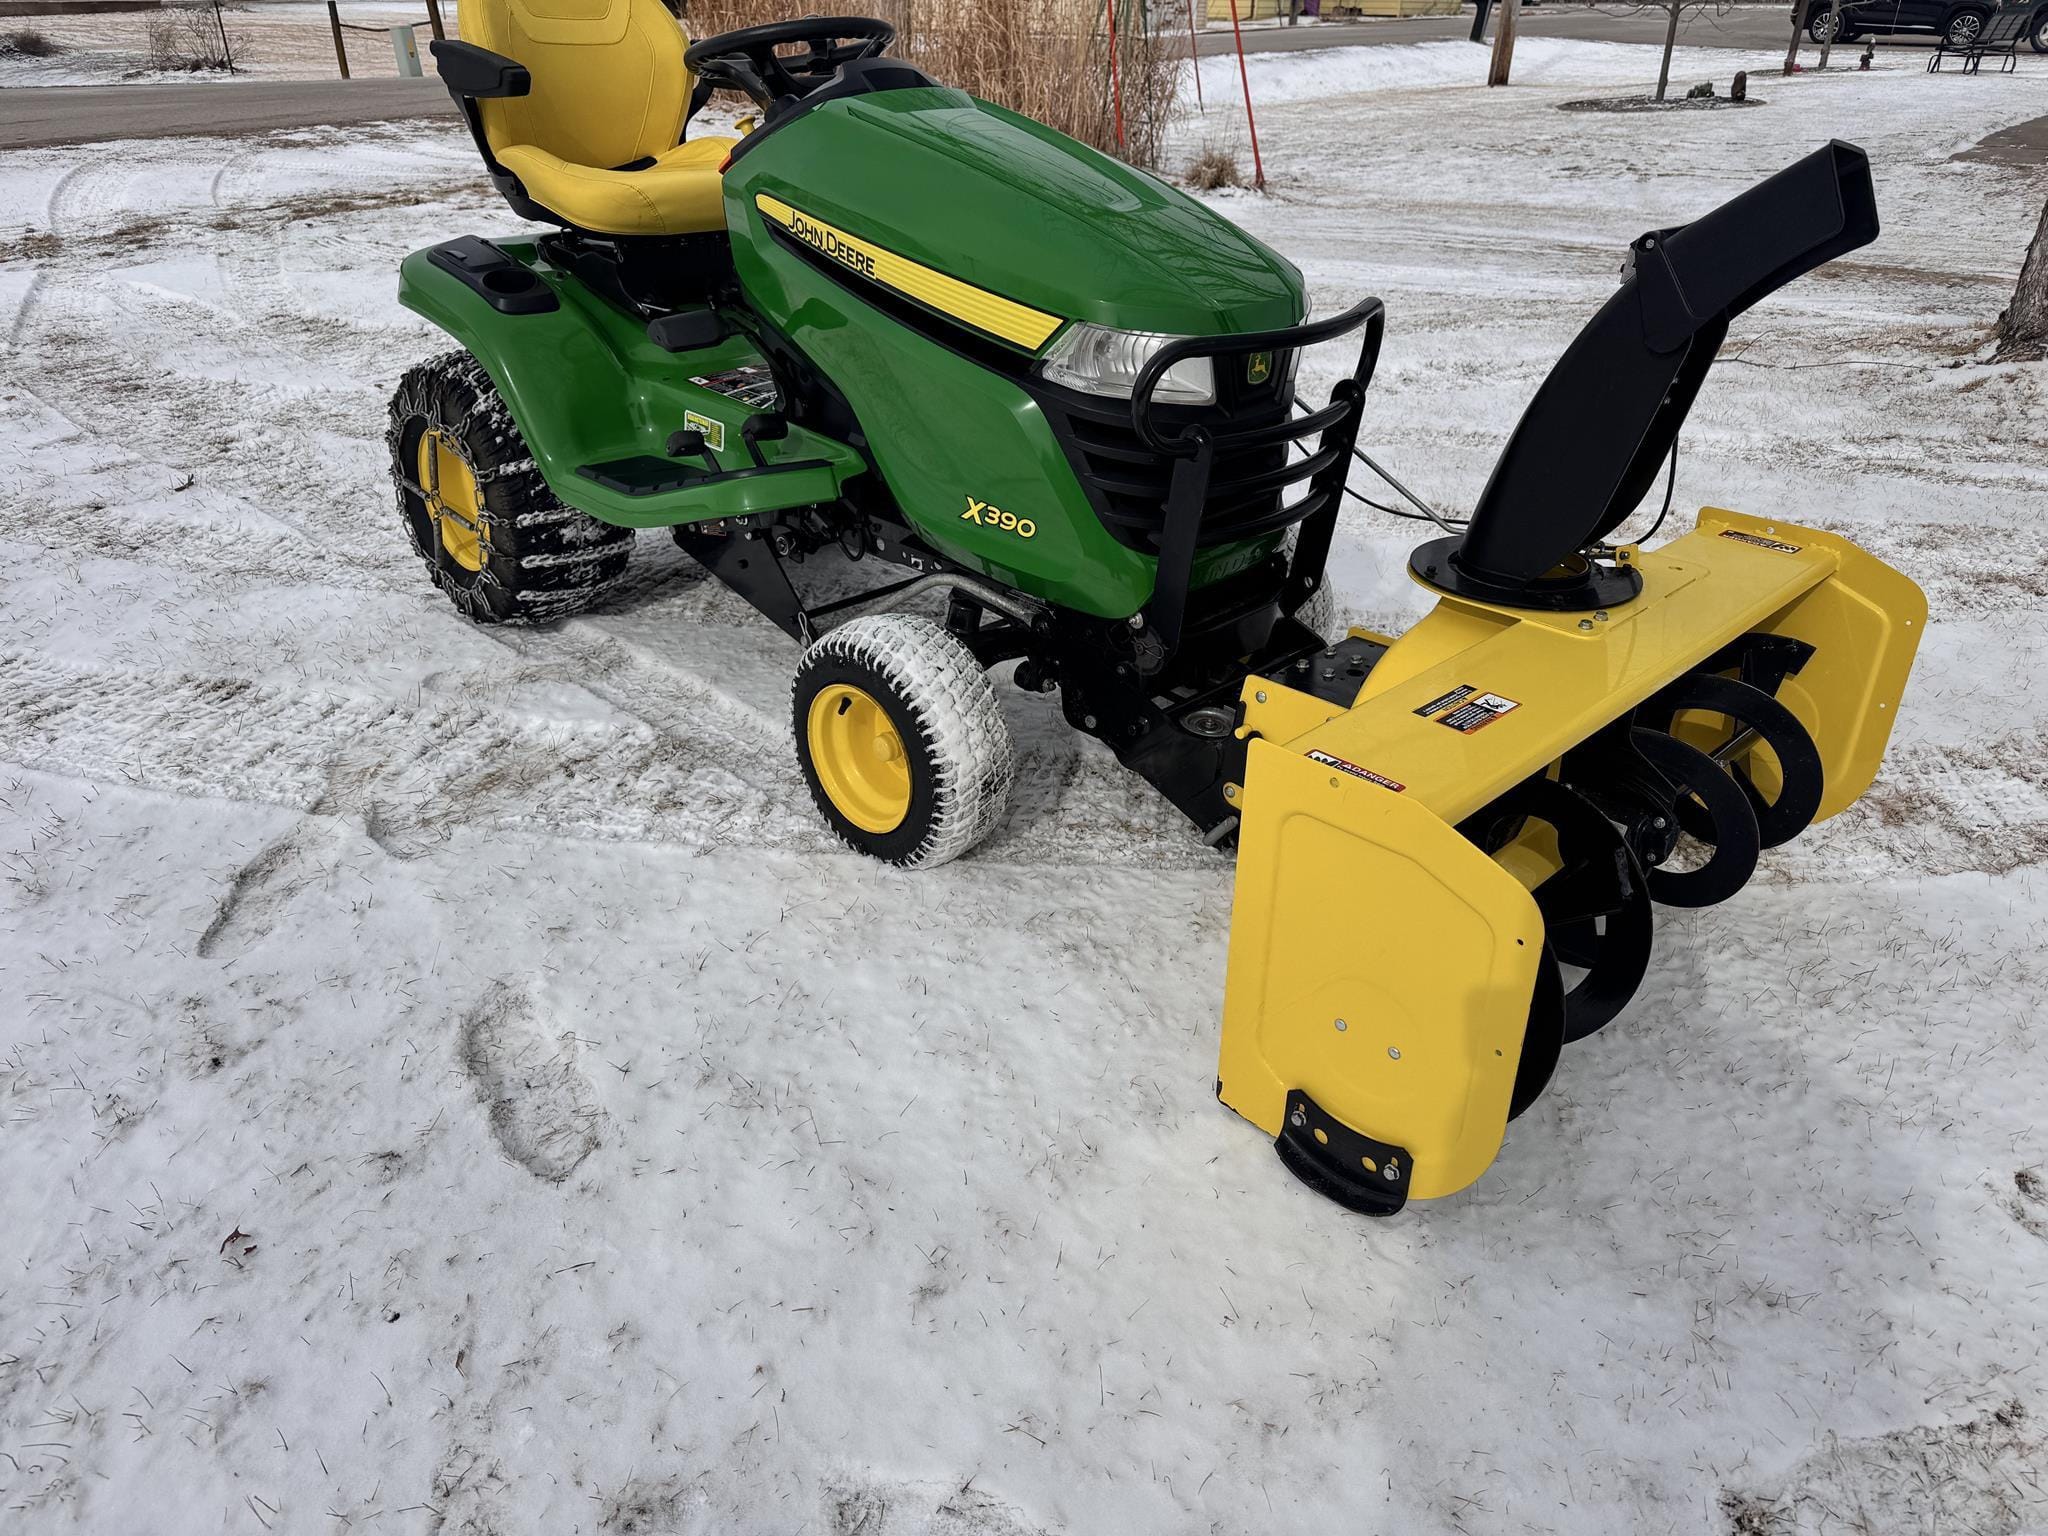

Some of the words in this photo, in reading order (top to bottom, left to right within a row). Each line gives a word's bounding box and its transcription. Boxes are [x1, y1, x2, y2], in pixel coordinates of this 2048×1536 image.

[788, 210, 823, 249] JOHN
[826, 230, 876, 278] DEERE
[959, 495, 1037, 539] X390
[1351, 764, 1400, 790] DANGER
